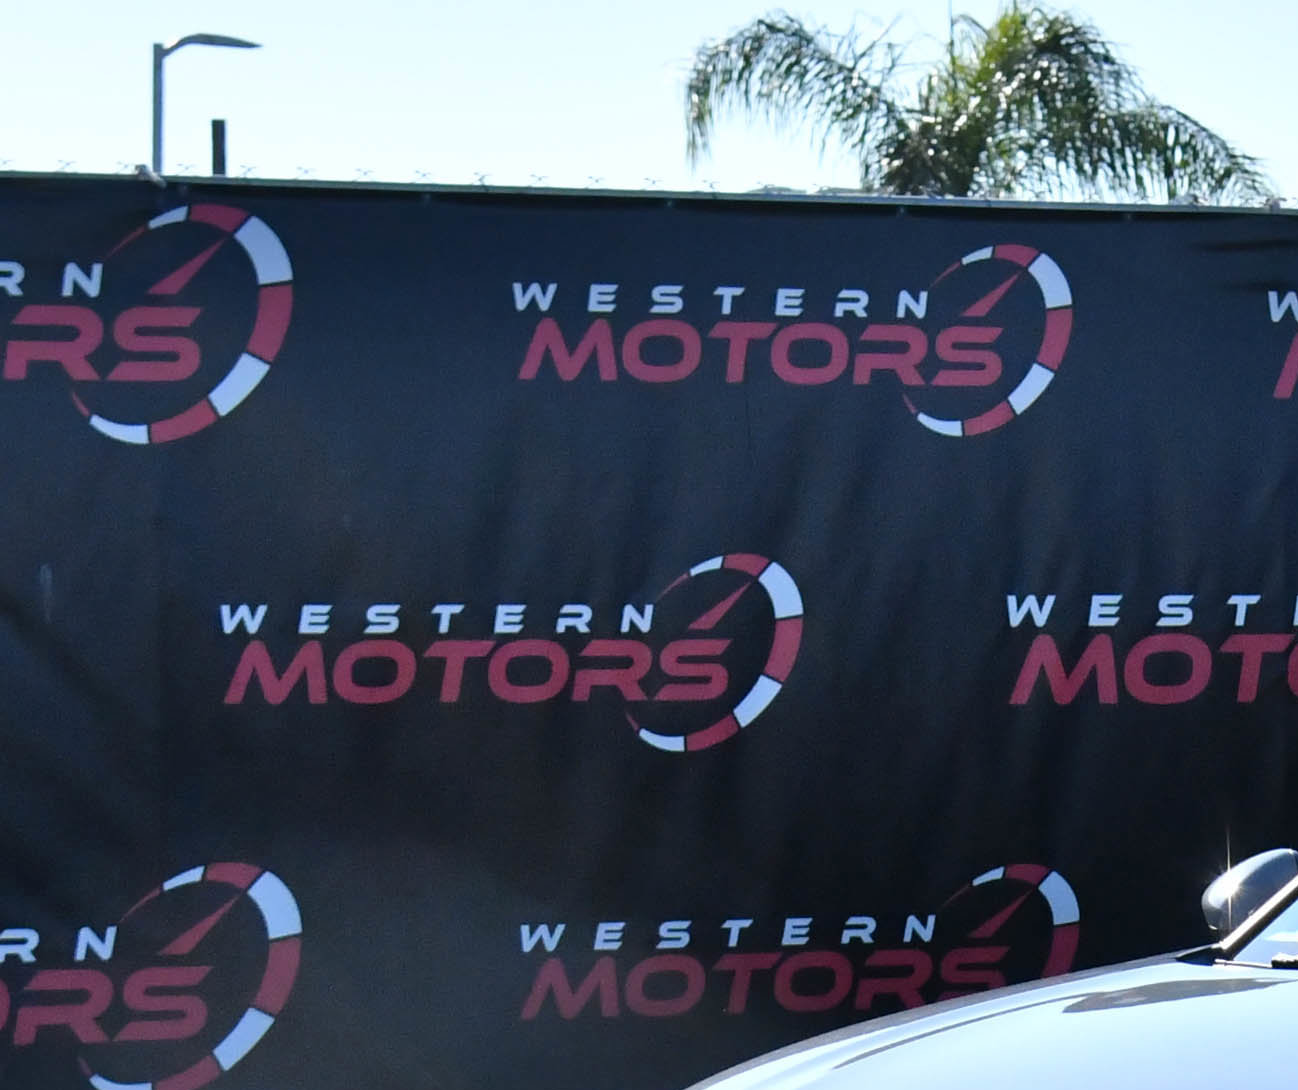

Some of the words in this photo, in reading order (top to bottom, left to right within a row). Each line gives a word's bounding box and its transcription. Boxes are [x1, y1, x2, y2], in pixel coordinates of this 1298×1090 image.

[512, 282, 929, 319] WESTERN
[518, 317, 1004, 387] MOTORS
[220, 603, 654, 634] WESTERN
[223, 638, 732, 705] MOTORS
[519, 914, 936, 952] WESTERN
[521, 946, 1010, 1021] MOTORS
